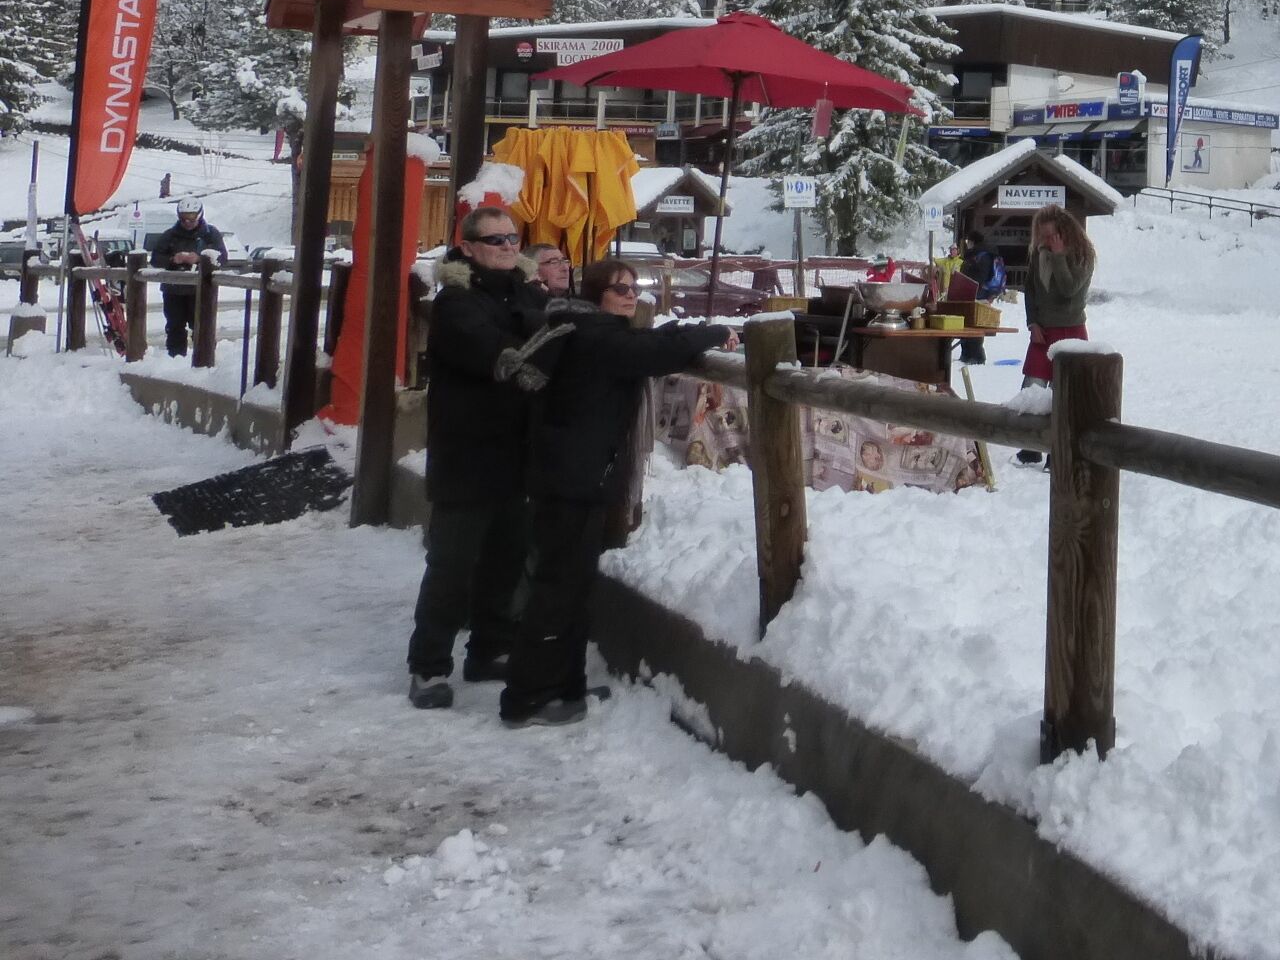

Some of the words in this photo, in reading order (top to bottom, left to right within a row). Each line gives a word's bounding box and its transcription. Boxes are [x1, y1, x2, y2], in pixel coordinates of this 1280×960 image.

[537, 41, 586, 51] SKIRAMA
[592, 40, 620, 51] 2000
[1005, 189, 1059, 198] NAVETTE
